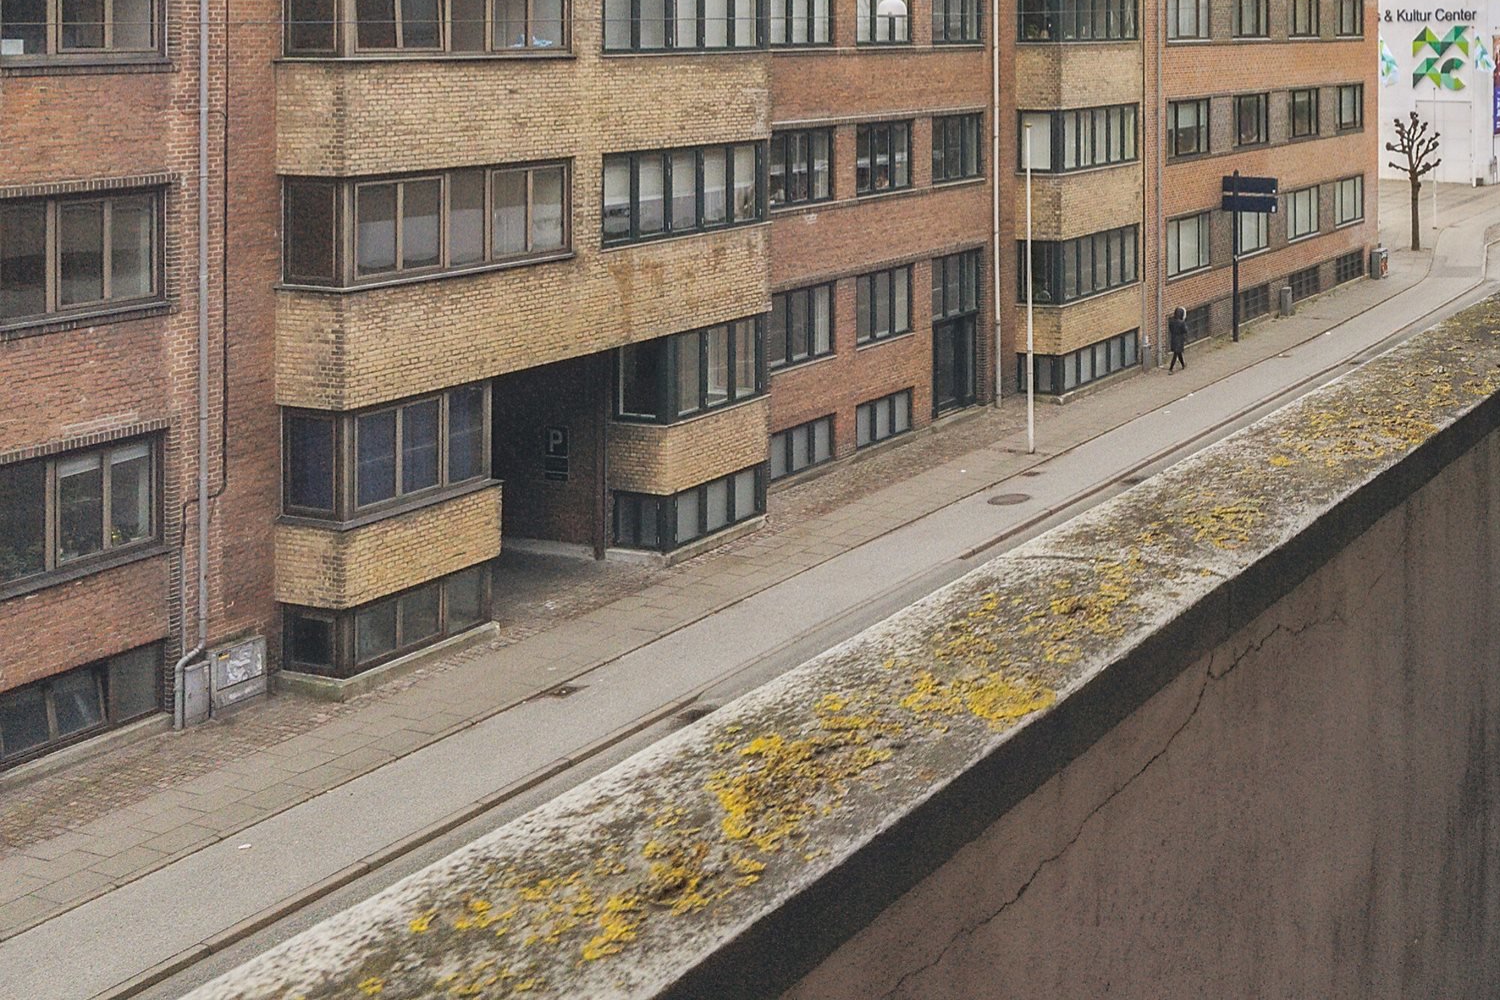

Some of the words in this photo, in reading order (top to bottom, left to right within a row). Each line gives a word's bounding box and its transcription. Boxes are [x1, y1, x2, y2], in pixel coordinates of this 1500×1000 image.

[1384, 9, 1393, 22] &
[1397, 9, 1432, 22] Kultur
[1435, 8, 1477, 21] Center
[550, 430, 562, 452] P
